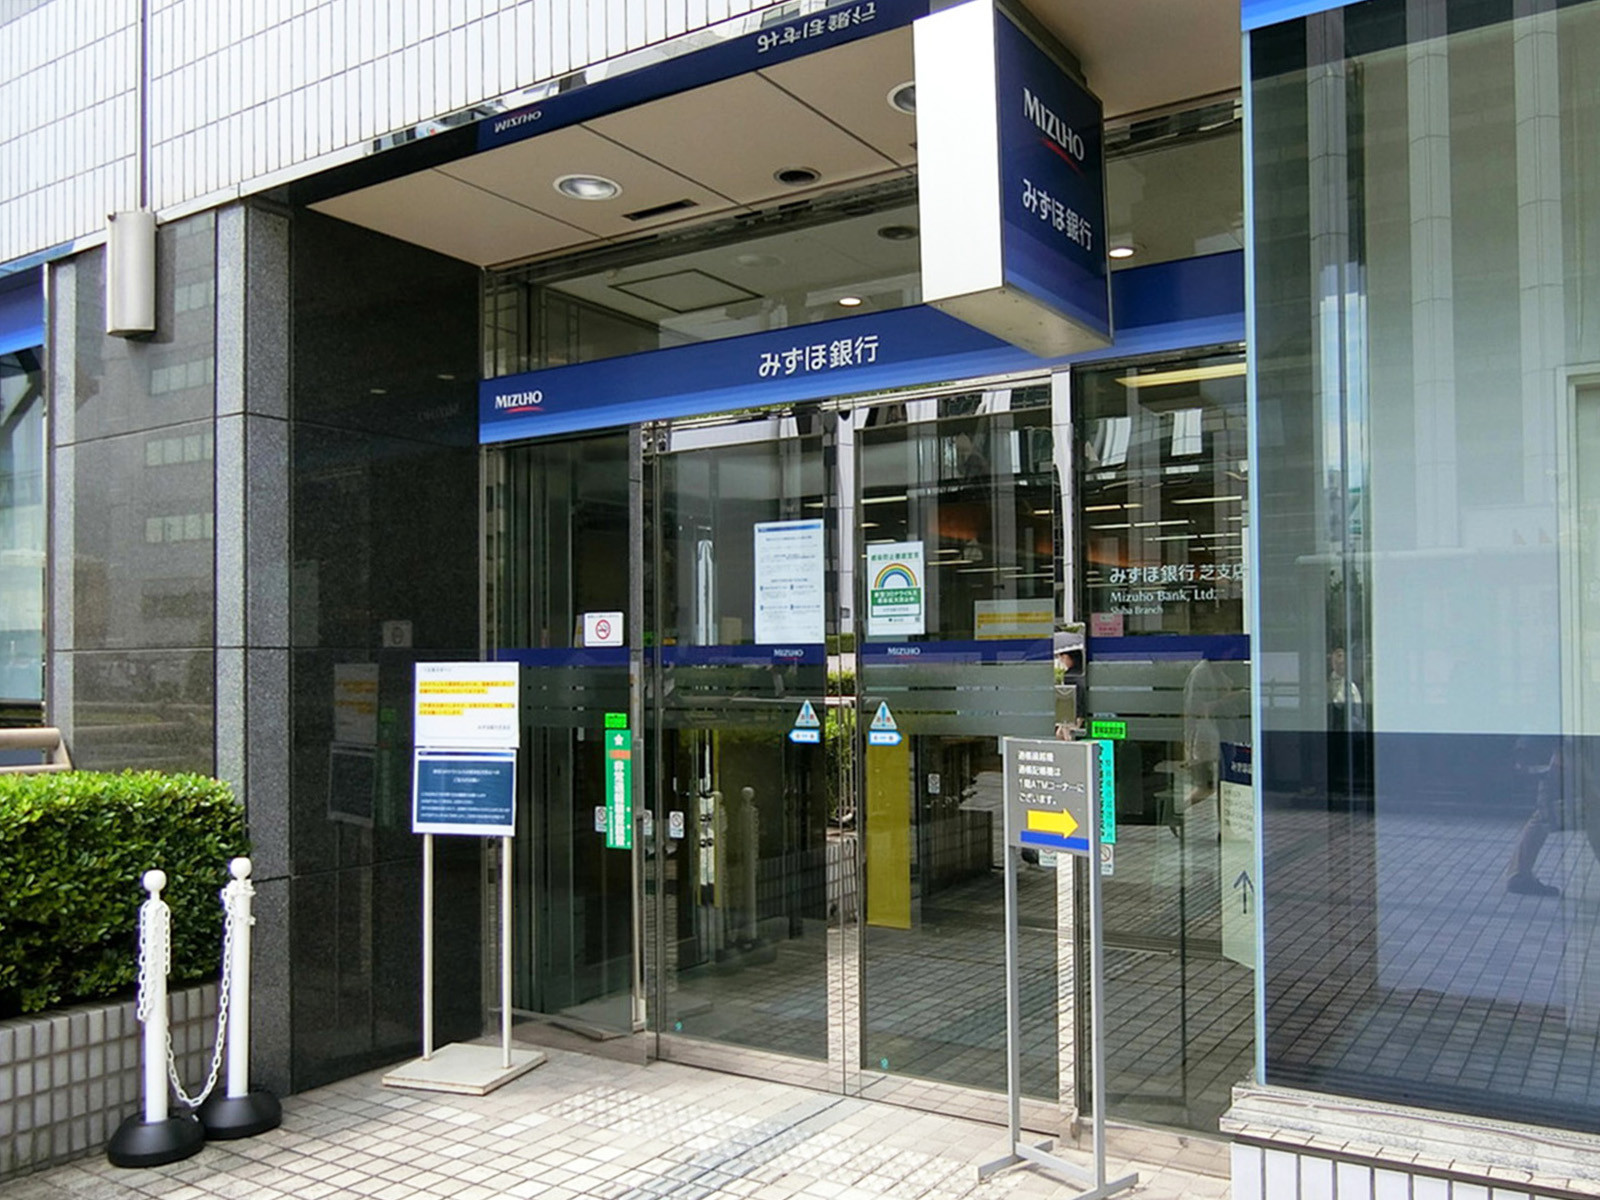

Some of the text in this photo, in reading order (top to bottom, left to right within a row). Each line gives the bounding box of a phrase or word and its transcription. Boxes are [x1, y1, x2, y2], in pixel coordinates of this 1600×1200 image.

[1023, 87, 1085, 161] MIZUHO
[1022, 178, 1092, 251] みずほ銀行
[759, 335, 879, 377] みずほ銀行
[495, 390, 543, 409] MIZUHO
[1109, 564, 1195, 584] みずほ銀行
[1110, 591, 1153, 602] Mizuho
[1194, 588, 1217, 600] Ltd.
[1110, 605, 1163, 615] Shiba Branch
[774, 649, 804, 657] MIZUHO
[887, 647, 920, 655] MIZUHO
